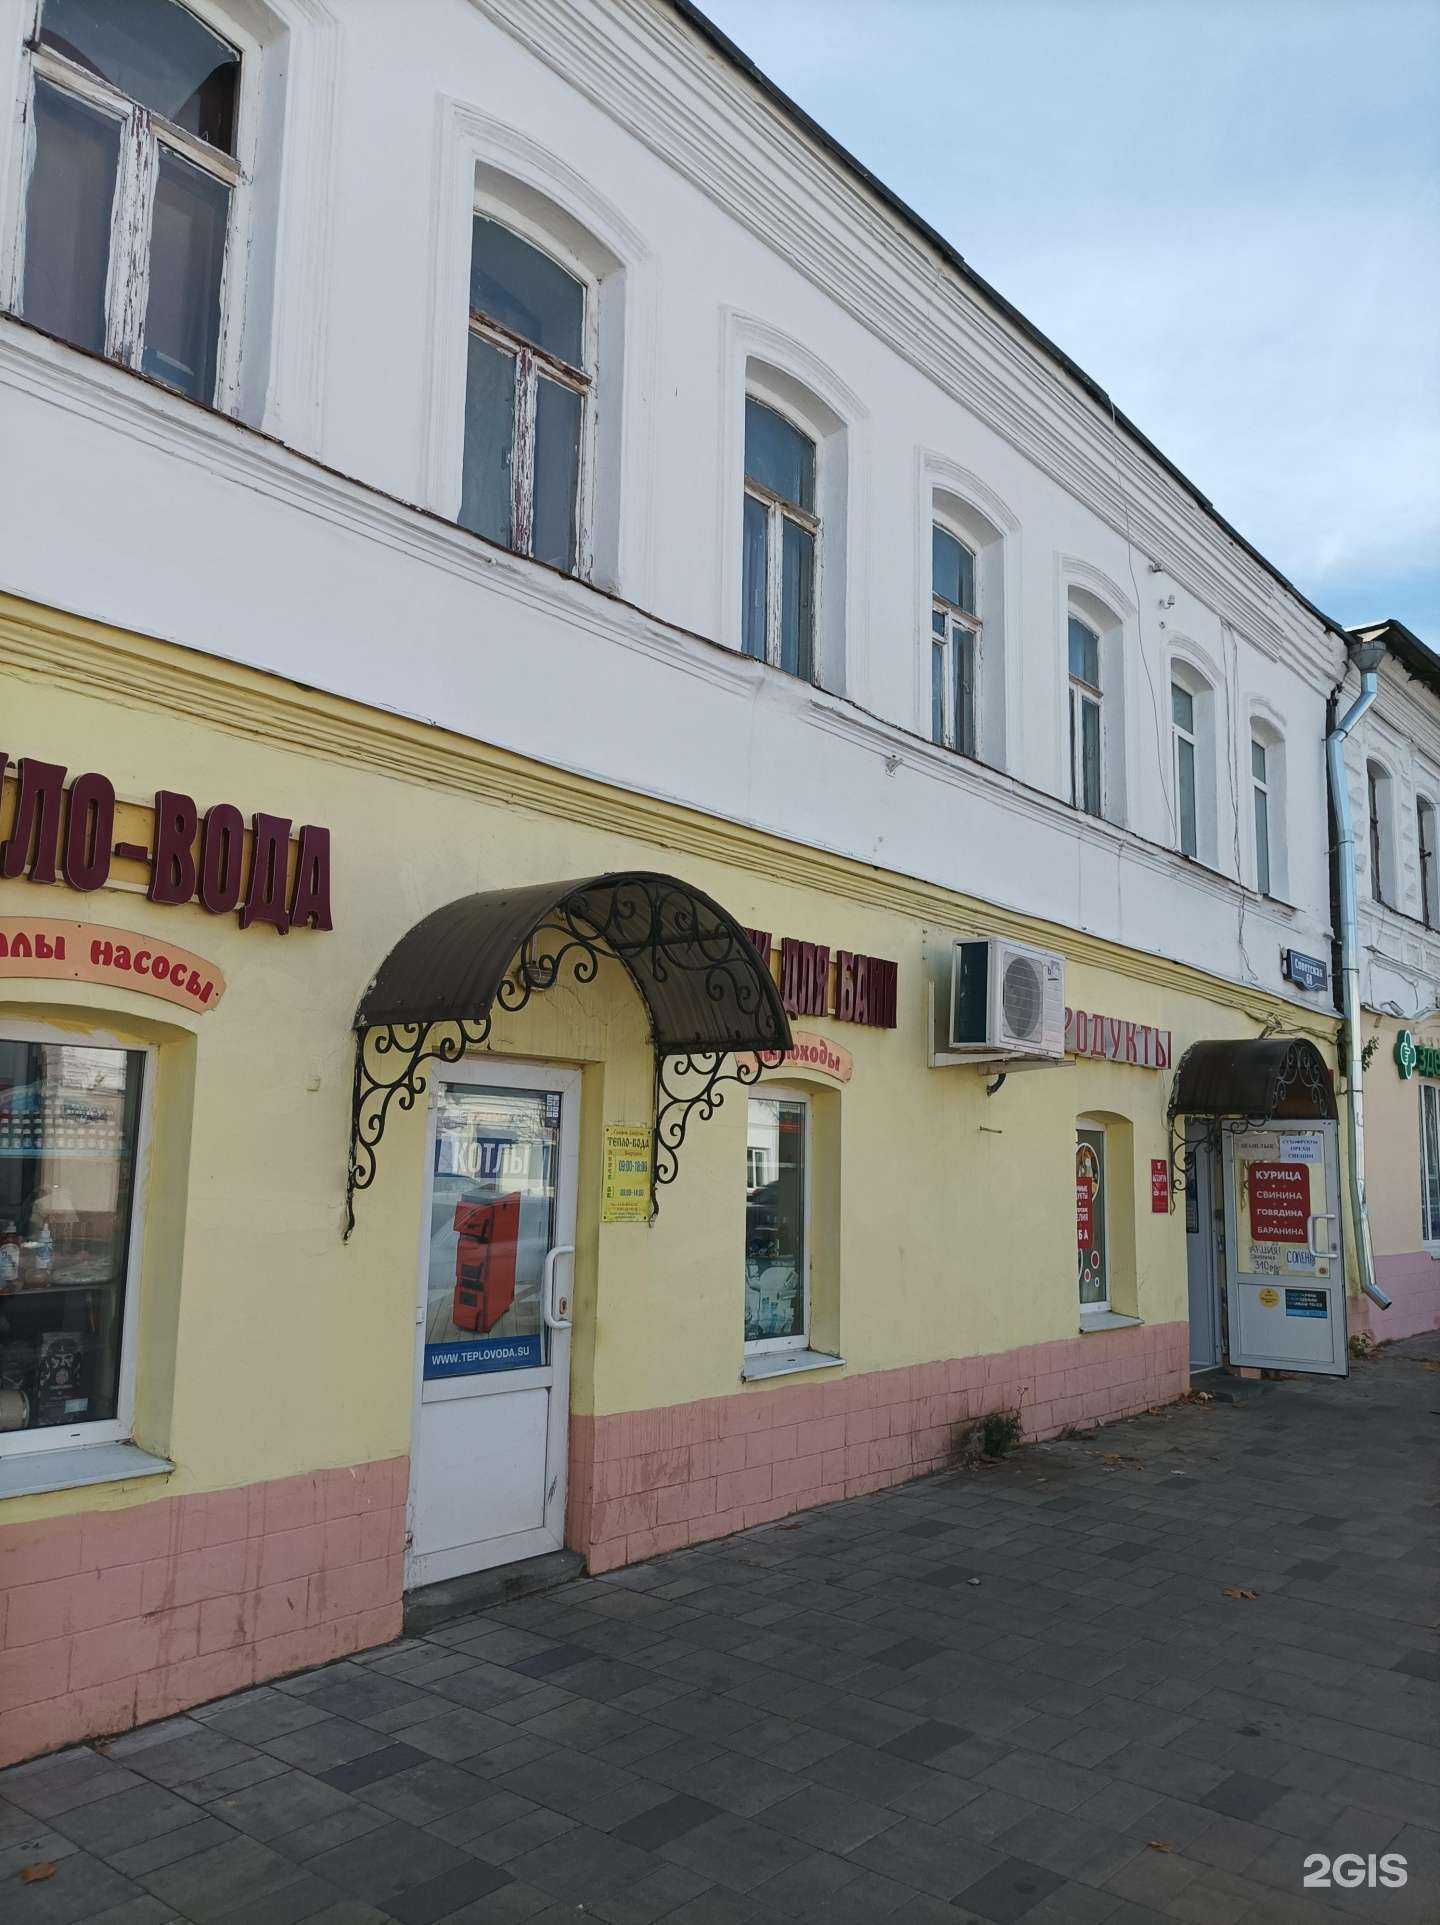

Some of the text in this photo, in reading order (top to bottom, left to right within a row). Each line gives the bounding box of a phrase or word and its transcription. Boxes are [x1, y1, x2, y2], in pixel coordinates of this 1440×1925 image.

[0, 753, 333, 935] ЛО-ВОДА
[90, 939, 214, 1003] насосы
[781, 937, 830, 1020] ДЛЯ
[452, 1142, 531, 1175] КОТЛЫ
[1255, 1170, 1302, 1182] КУРИЦА
[1256, 1190, 1302, 1200] СВИНИНА
[1257, 1208, 1303, 1217] ГОВЯДИНА
[1257, 1226, 1304, 1236] БАРАНИНА
[432, 1346, 530, 1366] WWW.TEPLOVODA.SU
